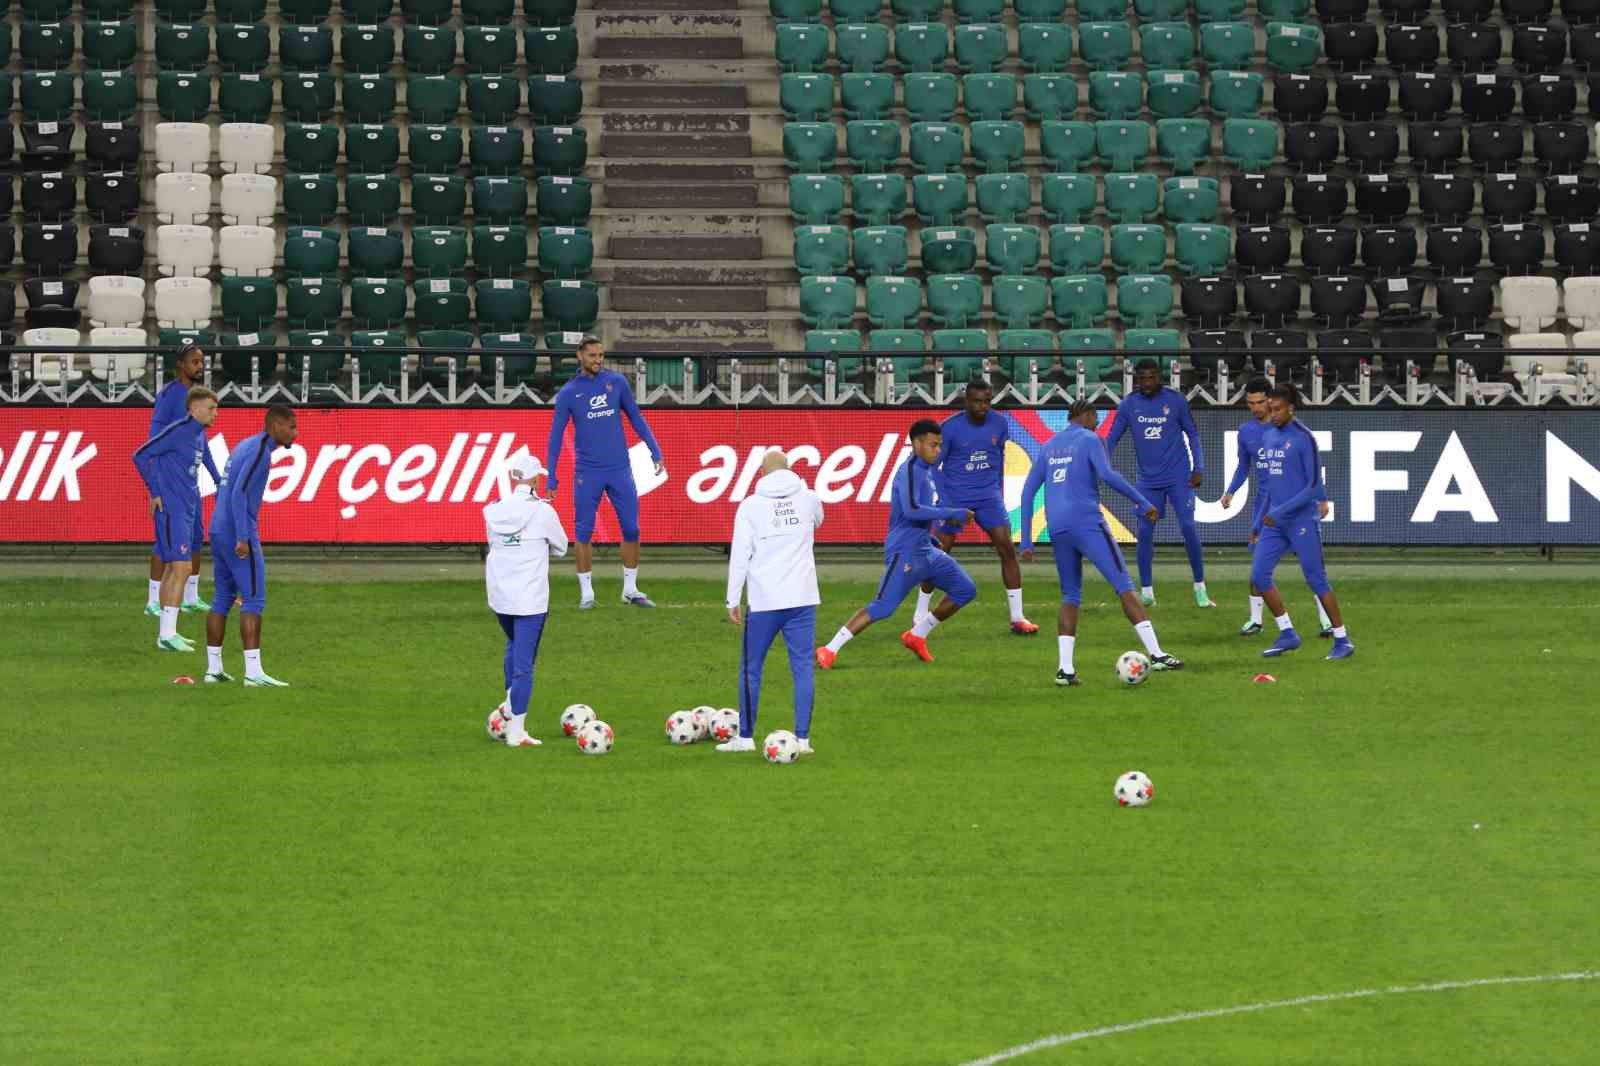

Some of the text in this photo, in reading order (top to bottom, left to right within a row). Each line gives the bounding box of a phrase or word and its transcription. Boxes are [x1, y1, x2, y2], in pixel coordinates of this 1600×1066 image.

[587, 409, 615, 419] Orange
[1137, 415, 1167, 424] Orange
[0, 431, 97, 501] lik
[262, 431, 530, 519] arçelik
